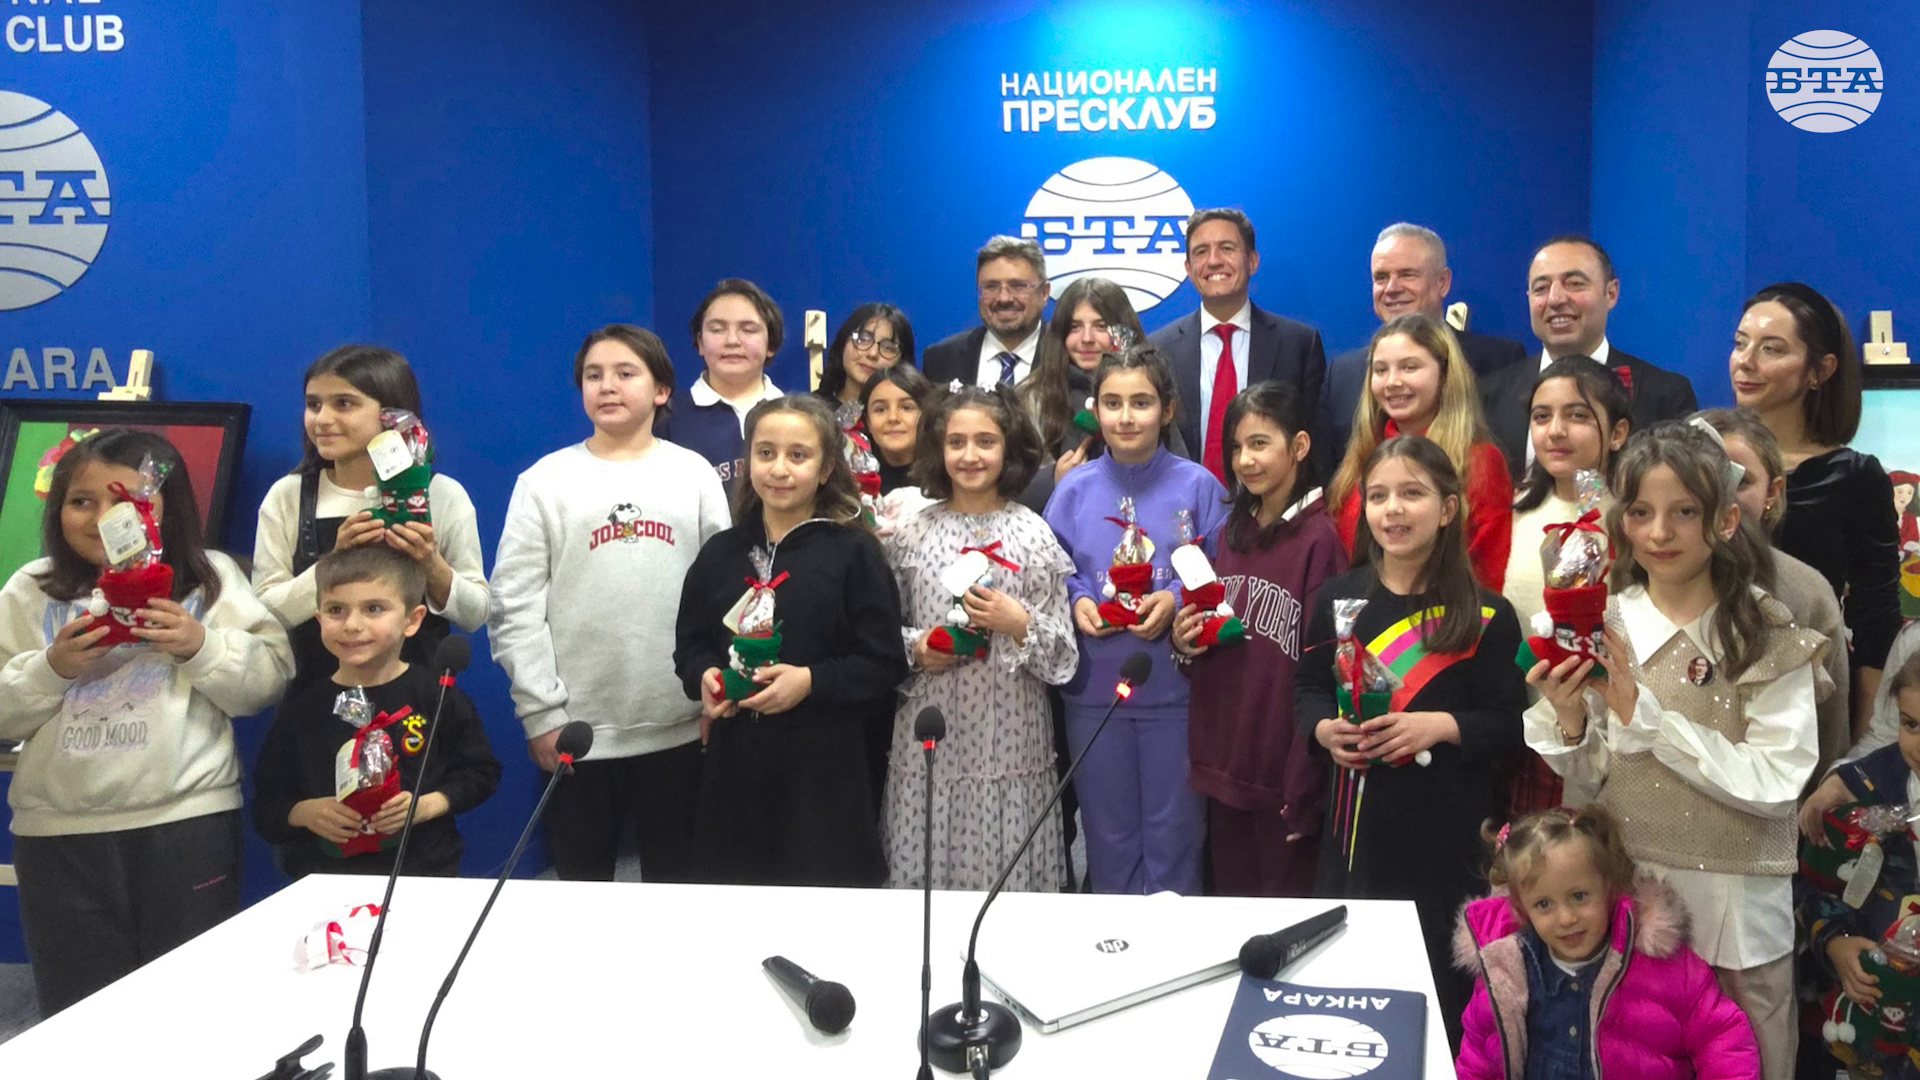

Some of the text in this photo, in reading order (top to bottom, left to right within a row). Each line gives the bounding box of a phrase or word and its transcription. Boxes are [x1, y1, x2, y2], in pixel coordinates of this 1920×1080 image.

[5, 14, 125, 53] CLUB
[1001, 67, 1217, 98] НАЦИОНАЛЕН
[1002, 96, 1217, 133] ПРЕСКЛУБ
[589, 520, 675, 551] JOE COOL
[1241, 576, 1302, 661] YORK
[62, 720, 149, 749] GOOD MOOD
[1095, 938, 1129, 954] hp
[1263, 987, 1391, 1010] АНКАРА
